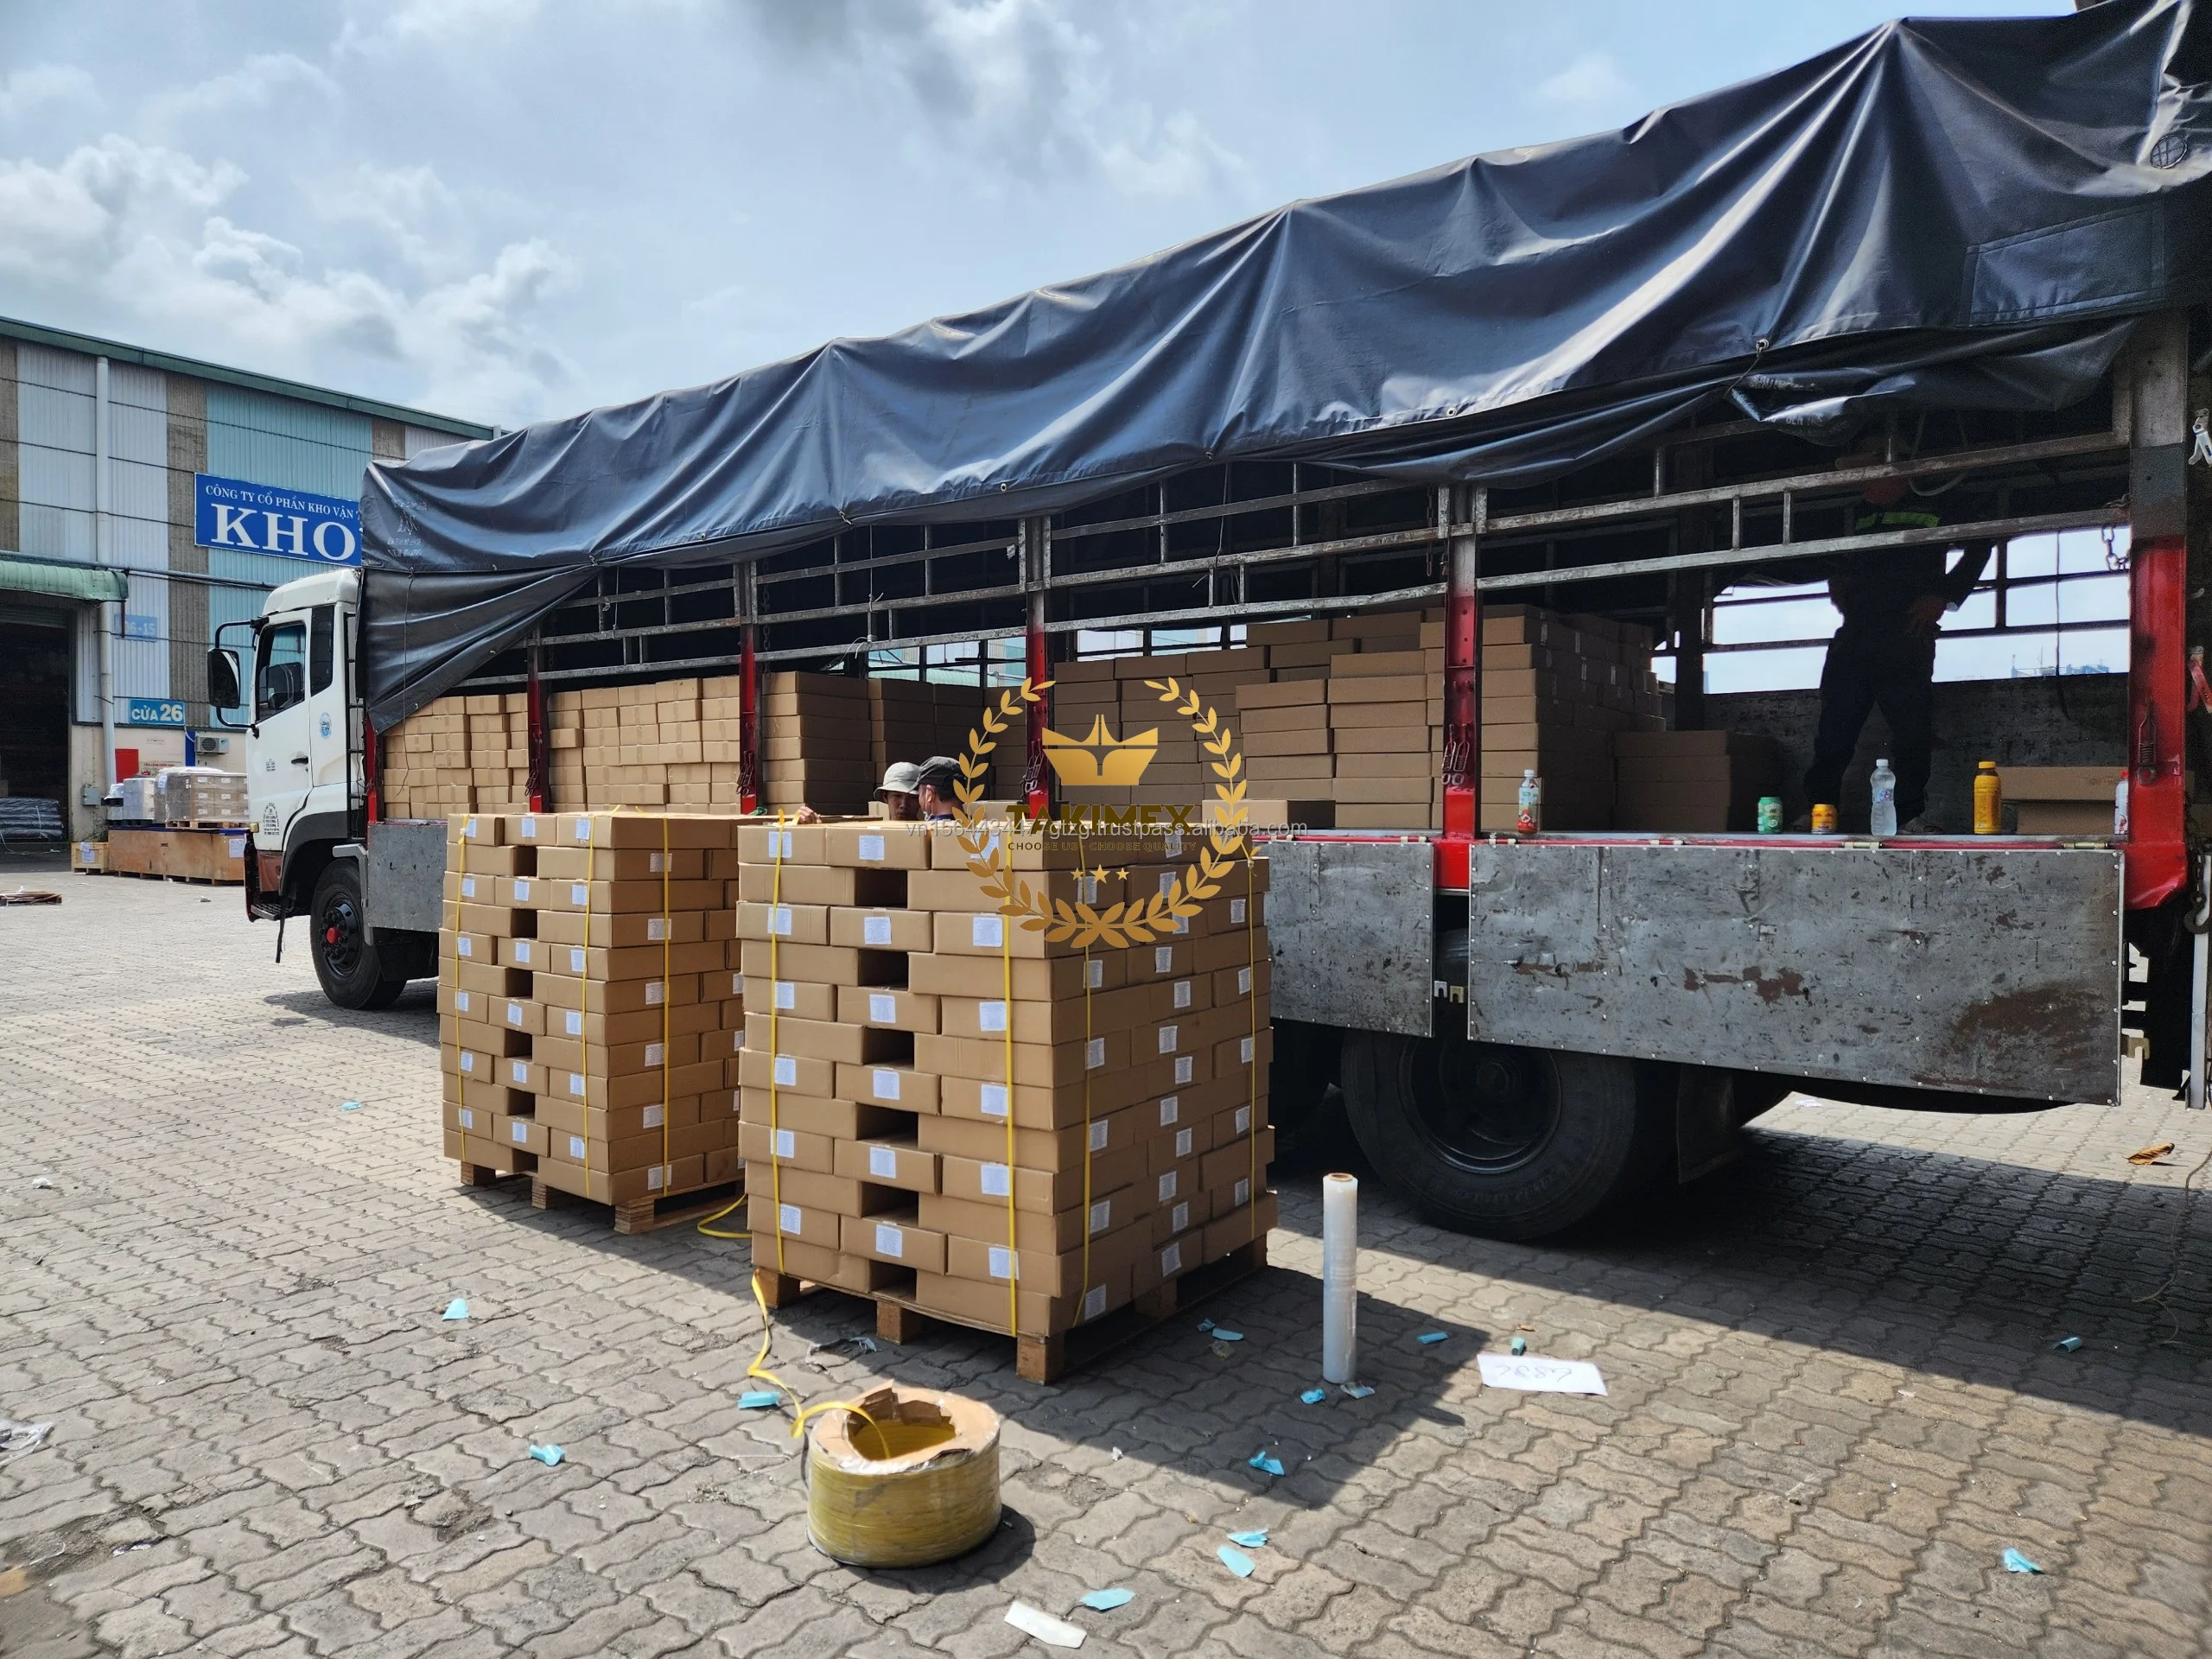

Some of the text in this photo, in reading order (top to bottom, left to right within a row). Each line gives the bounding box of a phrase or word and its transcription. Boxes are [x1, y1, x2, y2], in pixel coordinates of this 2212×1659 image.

[205, 483, 238, 499] CÔNG
[240, 491, 255, 502] TY
[257, 491, 273, 505] CỔ
[276, 495, 305, 511] PHẦN
[308, 502, 331, 515] KHO
[333, 505, 353, 520] VẬN
[211, 503, 356, 561] KHO
[131, 703, 183, 722] CỬA 26
